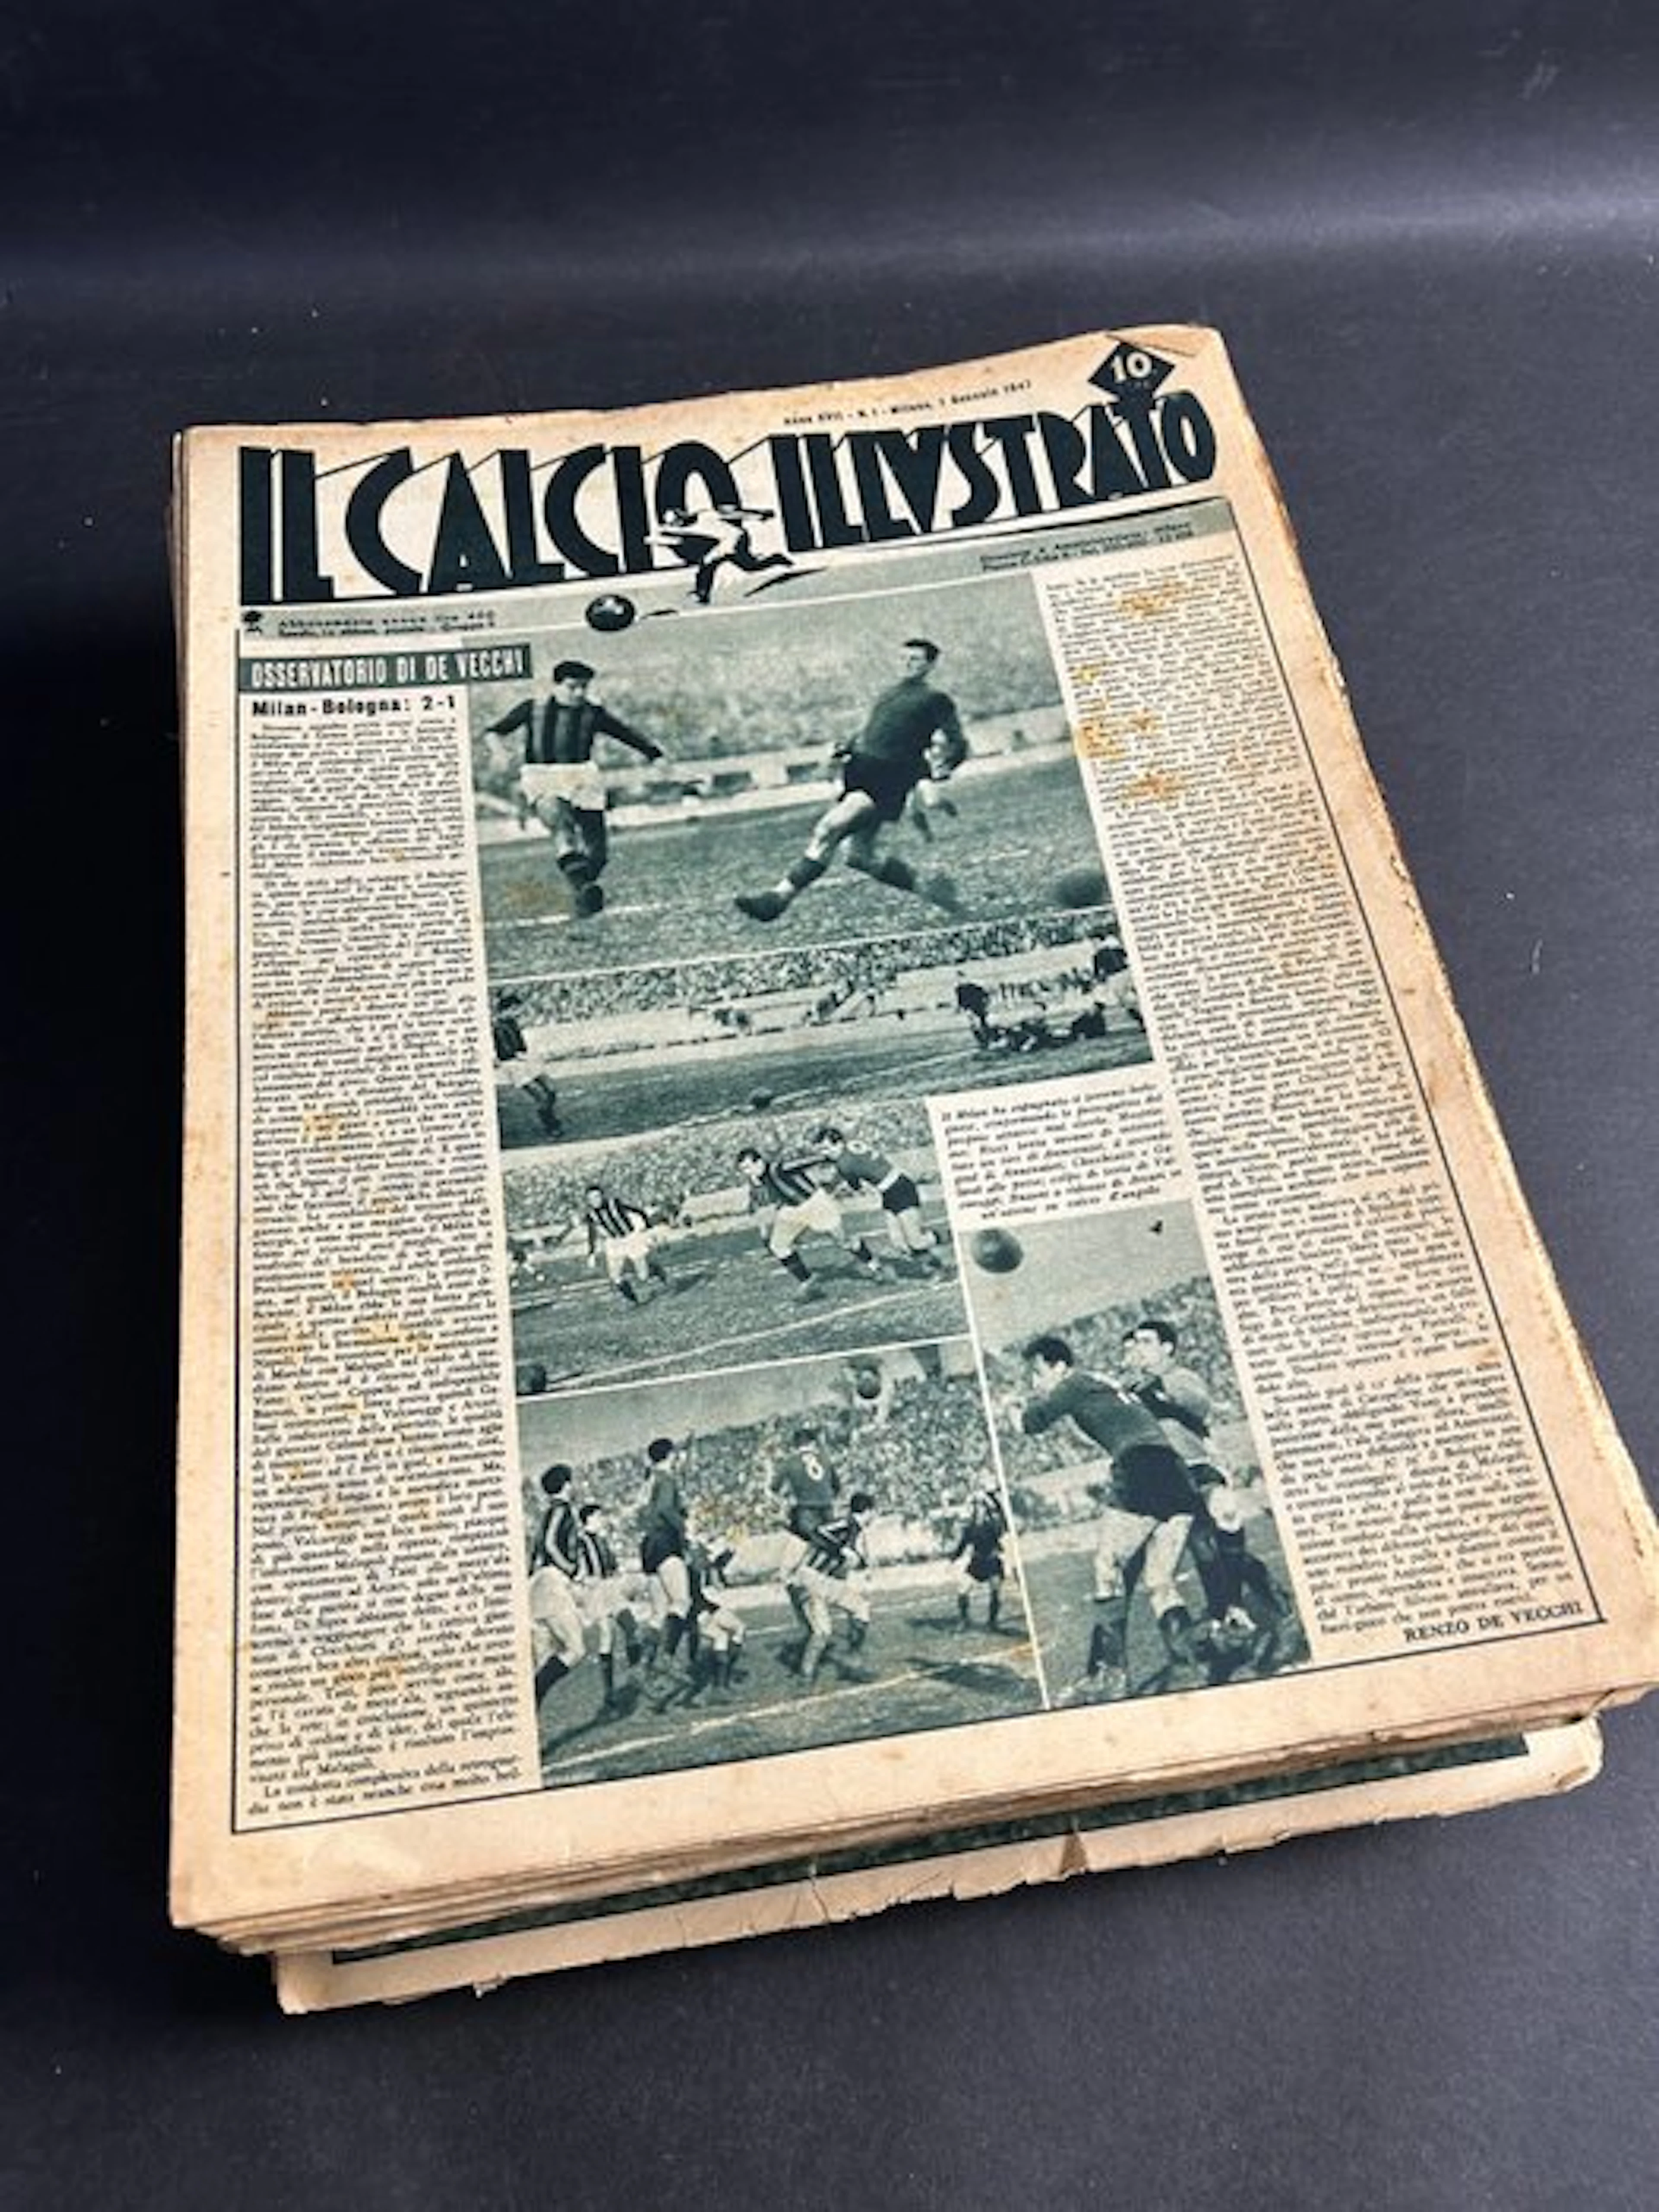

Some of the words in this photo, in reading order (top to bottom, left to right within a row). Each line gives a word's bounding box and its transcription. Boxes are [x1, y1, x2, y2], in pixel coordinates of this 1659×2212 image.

[1110, 352, 1153, 384] 10
[239, 446, 334, 605] IL
[345, 440, 742, 597] CALCIO
[251, 657, 387, 689] OSSERVATORIO
[396, 655, 416, 685] DI
[425, 655, 448, 683] DE
[456, 648, 524, 678] VECCHI
[1403, 1618, 1469, 1642] RENZO
[1476, 1615, 1505, 1630] DE
[1510, 1600, 1583, 1624] VECCHI
